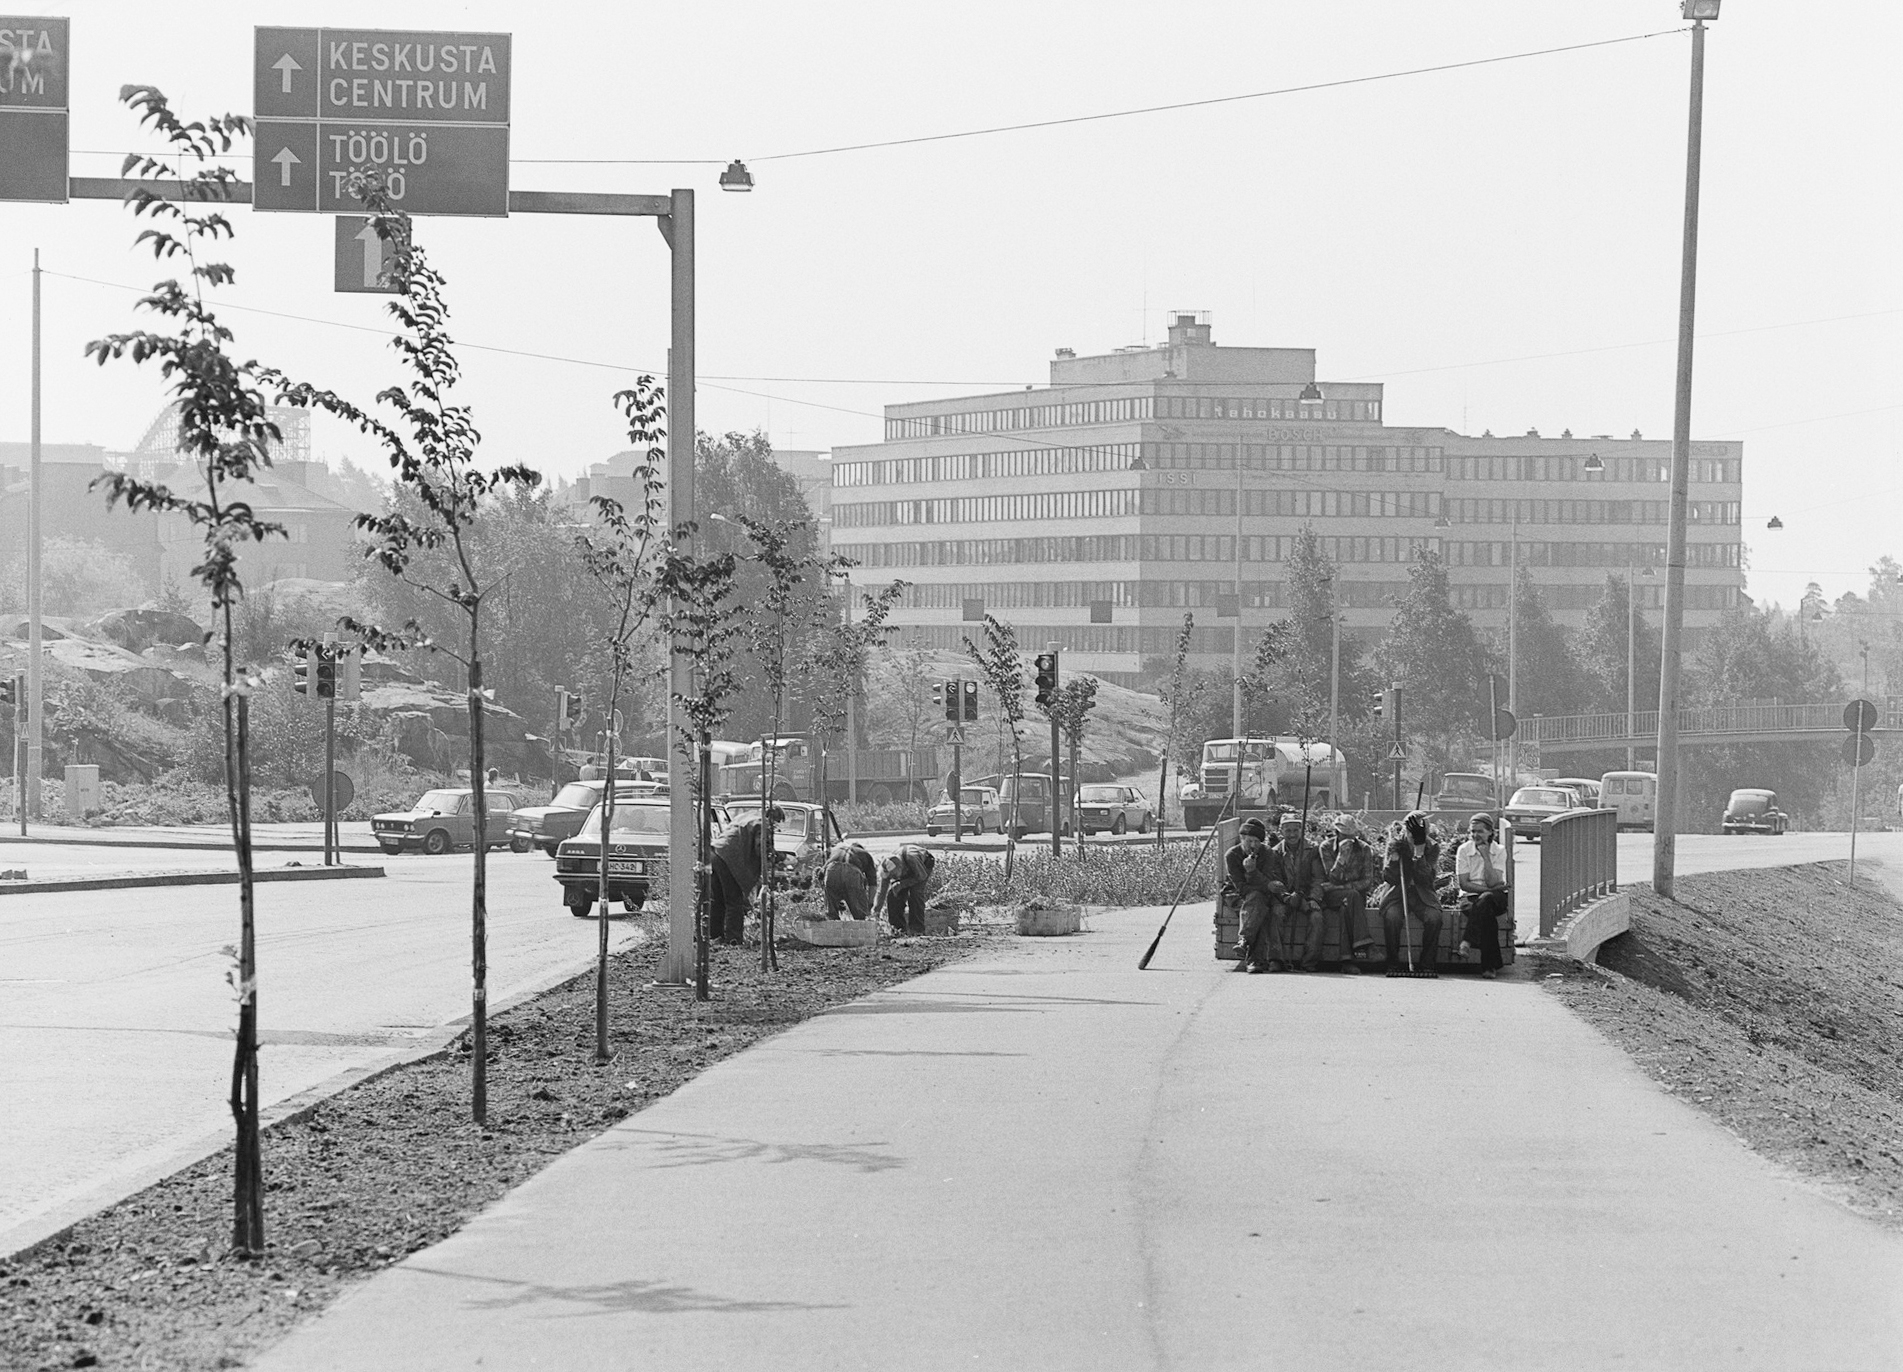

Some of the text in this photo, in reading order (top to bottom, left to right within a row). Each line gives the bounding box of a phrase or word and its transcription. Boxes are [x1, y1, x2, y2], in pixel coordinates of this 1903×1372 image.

[330, 41, 497, 74] KESKUSTA
[329, 78, 487, 110] CENTRUM
[329, 130, 427, 165] TÖÖLÖ
[329, 166, 405, 200] TÖÖ
[1267, 428, 1323, 441] BOSCH
